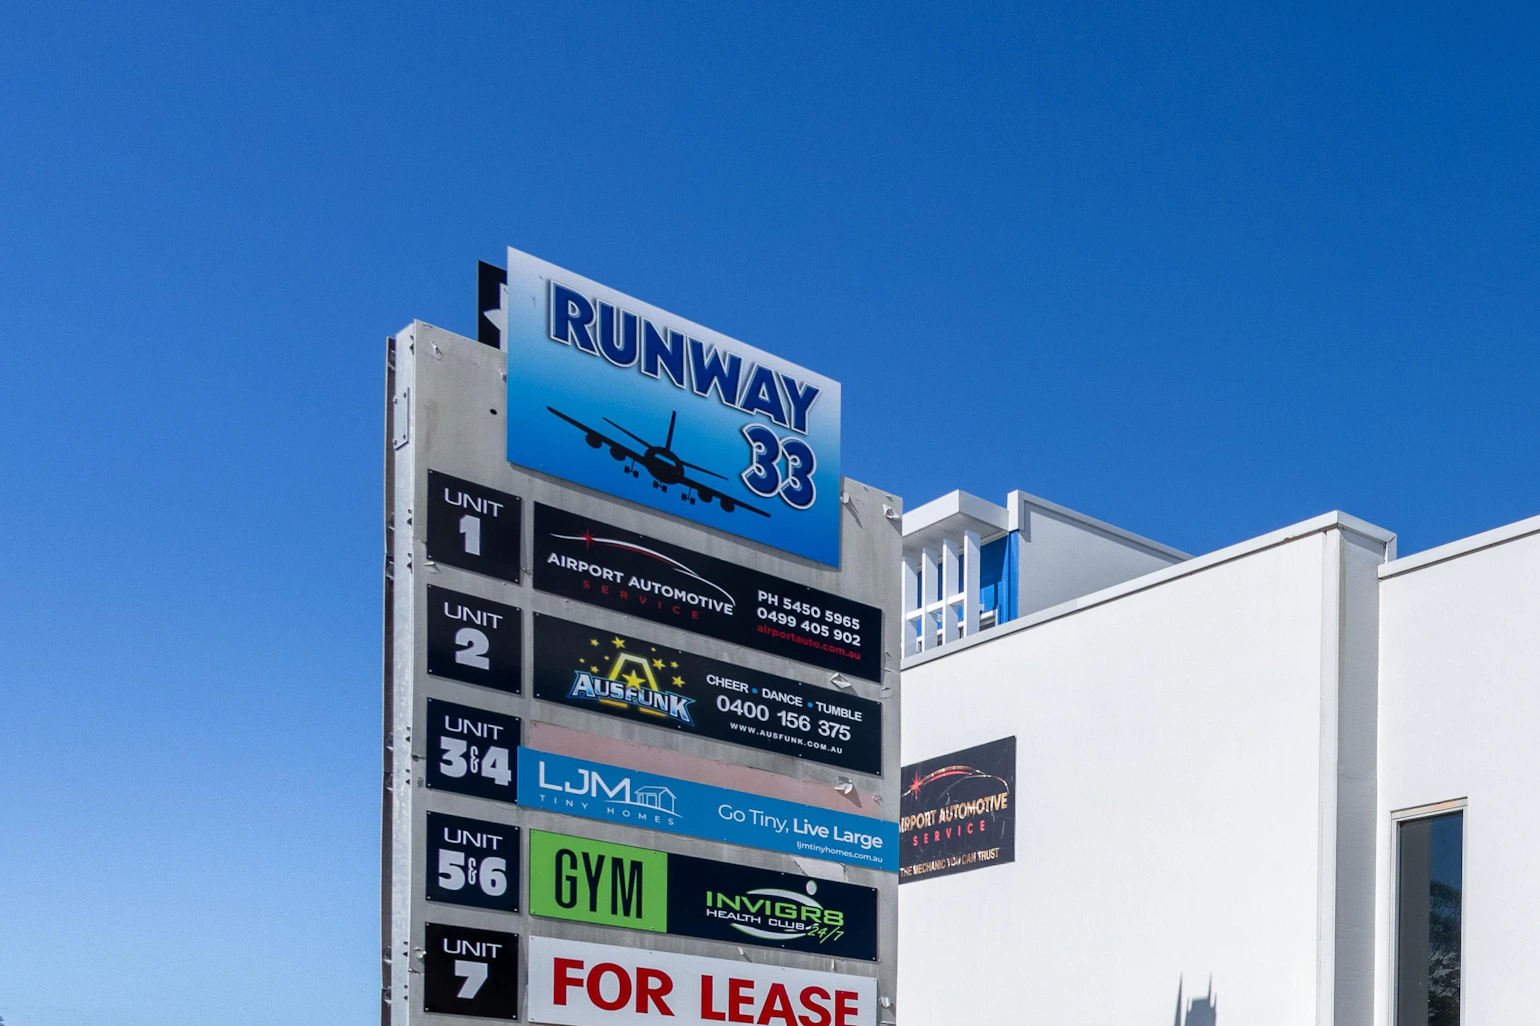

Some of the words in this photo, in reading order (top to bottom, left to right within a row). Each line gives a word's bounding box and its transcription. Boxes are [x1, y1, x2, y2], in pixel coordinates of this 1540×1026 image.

[550, 279, 820, 435] RUNWAY
[741, 423, 817, 510] 33
[444, 487, 504, 517] UNIT
[459, 514, 481, 556] 1
[547, 552, 624, 584] AIRPORT
[628, 576, 734, 616] AUTOMOTIVE
[583, 580, 699, 620] SERVICE
[444, 601, 503, 629] UNIT
[757, 589, 778, 607] PH
[783, 597, 821, 619] 5450
[825, 609, 860, 630] 5965
[757, 607, 796, 628] 0499
[801, 620, 829, 637] 405
[833, 629, 861, 647] 902
[455, 627, 490, 670] 2
[757, 624, 861, 660] airportauto.com.au
[568, 671, 695, 726] AUSFUNK
[706, 674, 749, 694] CHEER
[762, 688, 803, 707] DANCE
[816, 701, 863, 722] TUMBLE
[716, 695, 770, 722] 0400
[777, 710, 811, 732] 156
[818, 720, 851, 741] 375
[445, 715, 504, 740] UNIT
[730, 722, 843, 754] WWW.AUSFUNK.COM.AU
[440, 735, 512, 786] 3&4
[539, 760, 631, 803] LJM
[539, 794, 588, 809] TINY
[607, 807, 675, 826] HOMES
[718, 804, 745, 823] Go
[749, 809, 789, 833] Tiny,
[793, 818, 829, 838] Live
[833, 826, 883, 849] Large
[899, 810, 937, 833] AIRPORT
[938, 792, 1008, 824] AUTOMOTIVE
[444, 827, 503, 850] UNIT
[796, 841, 883, 863] ljmtinyhomes.com.au
[912, 820, 986, 847] SERVICE
[438, 848, 507, 896] 5&6
[900, 865, 912, 878] THE
[913, 859, 946, 876] MECHANIC
[947, 856, 961, 868] YOU
[961, 853, 976, 866] CAN
[977, 847, 1000, 862] TRUST
[555, 848, 643, 919] GYM
[706, 890, 844, 926] INVIGR8
[706, 908, 761, 924] HEALTH
[768, 918, 805, 931] CLUB
[807, 925, 844, 943] 24/7
[443, 938, 502, 958] UNIT
[454, 959, 488, 999] 7
[553, 957, 675, 1017] FOR
